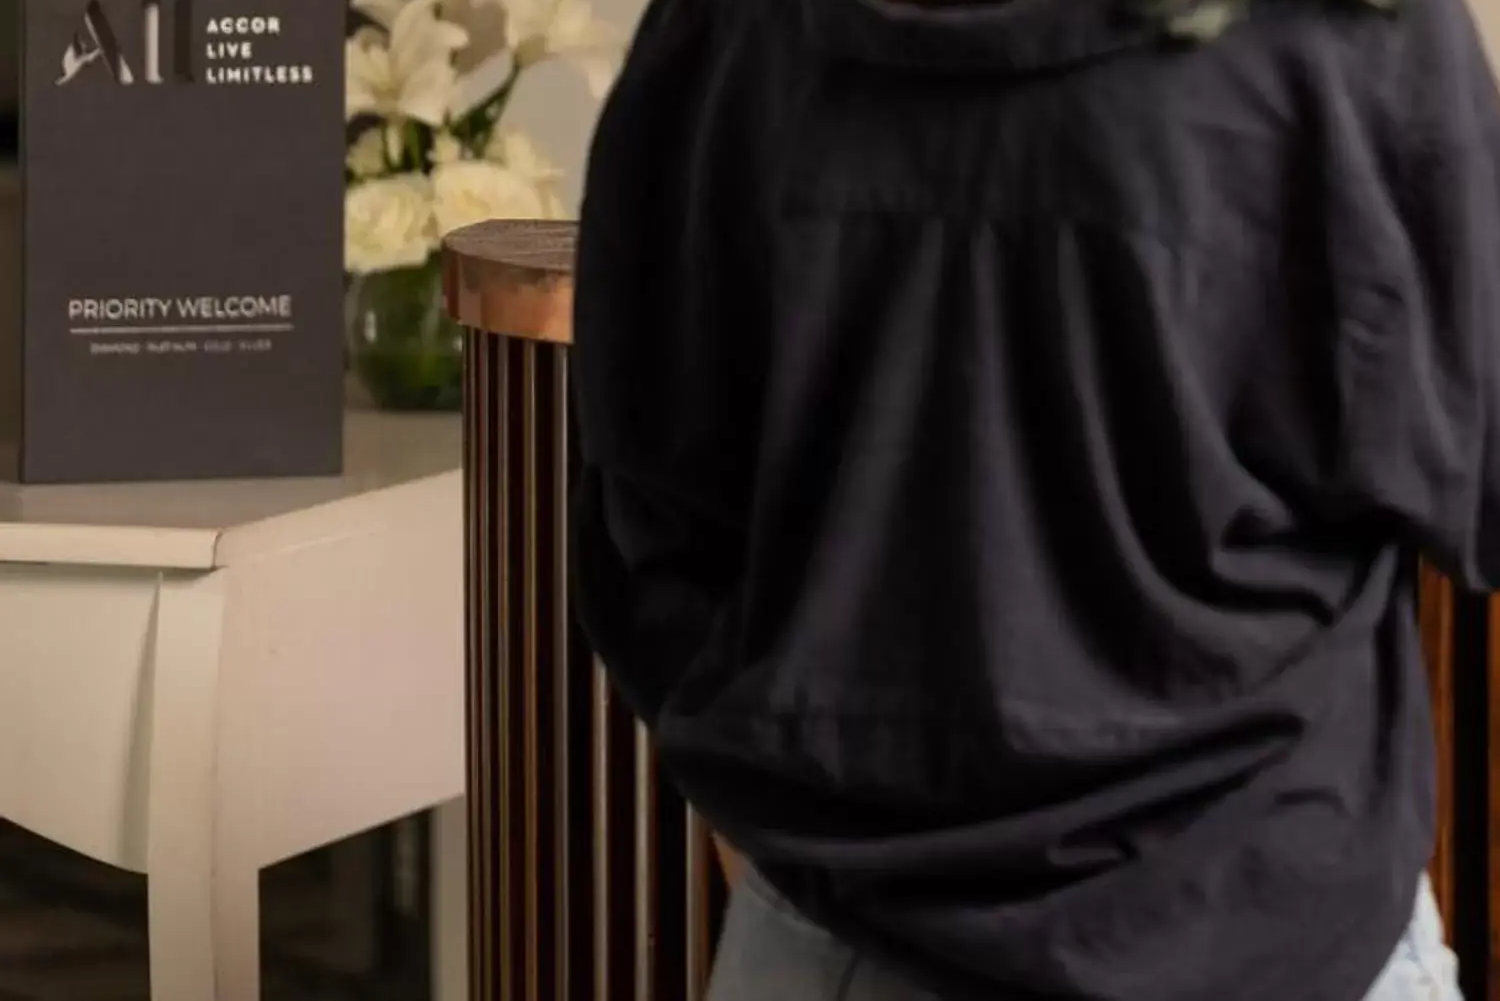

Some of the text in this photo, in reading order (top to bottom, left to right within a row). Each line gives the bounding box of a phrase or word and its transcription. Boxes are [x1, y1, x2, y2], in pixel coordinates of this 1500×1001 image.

[206, 17, 281, 34] ACCOR
[206, 42, 252, 59] LIVE
[206, 65, 313, 84] LIMITLESS
[68, 295, 292, 320] PRIORITY WELCOME
